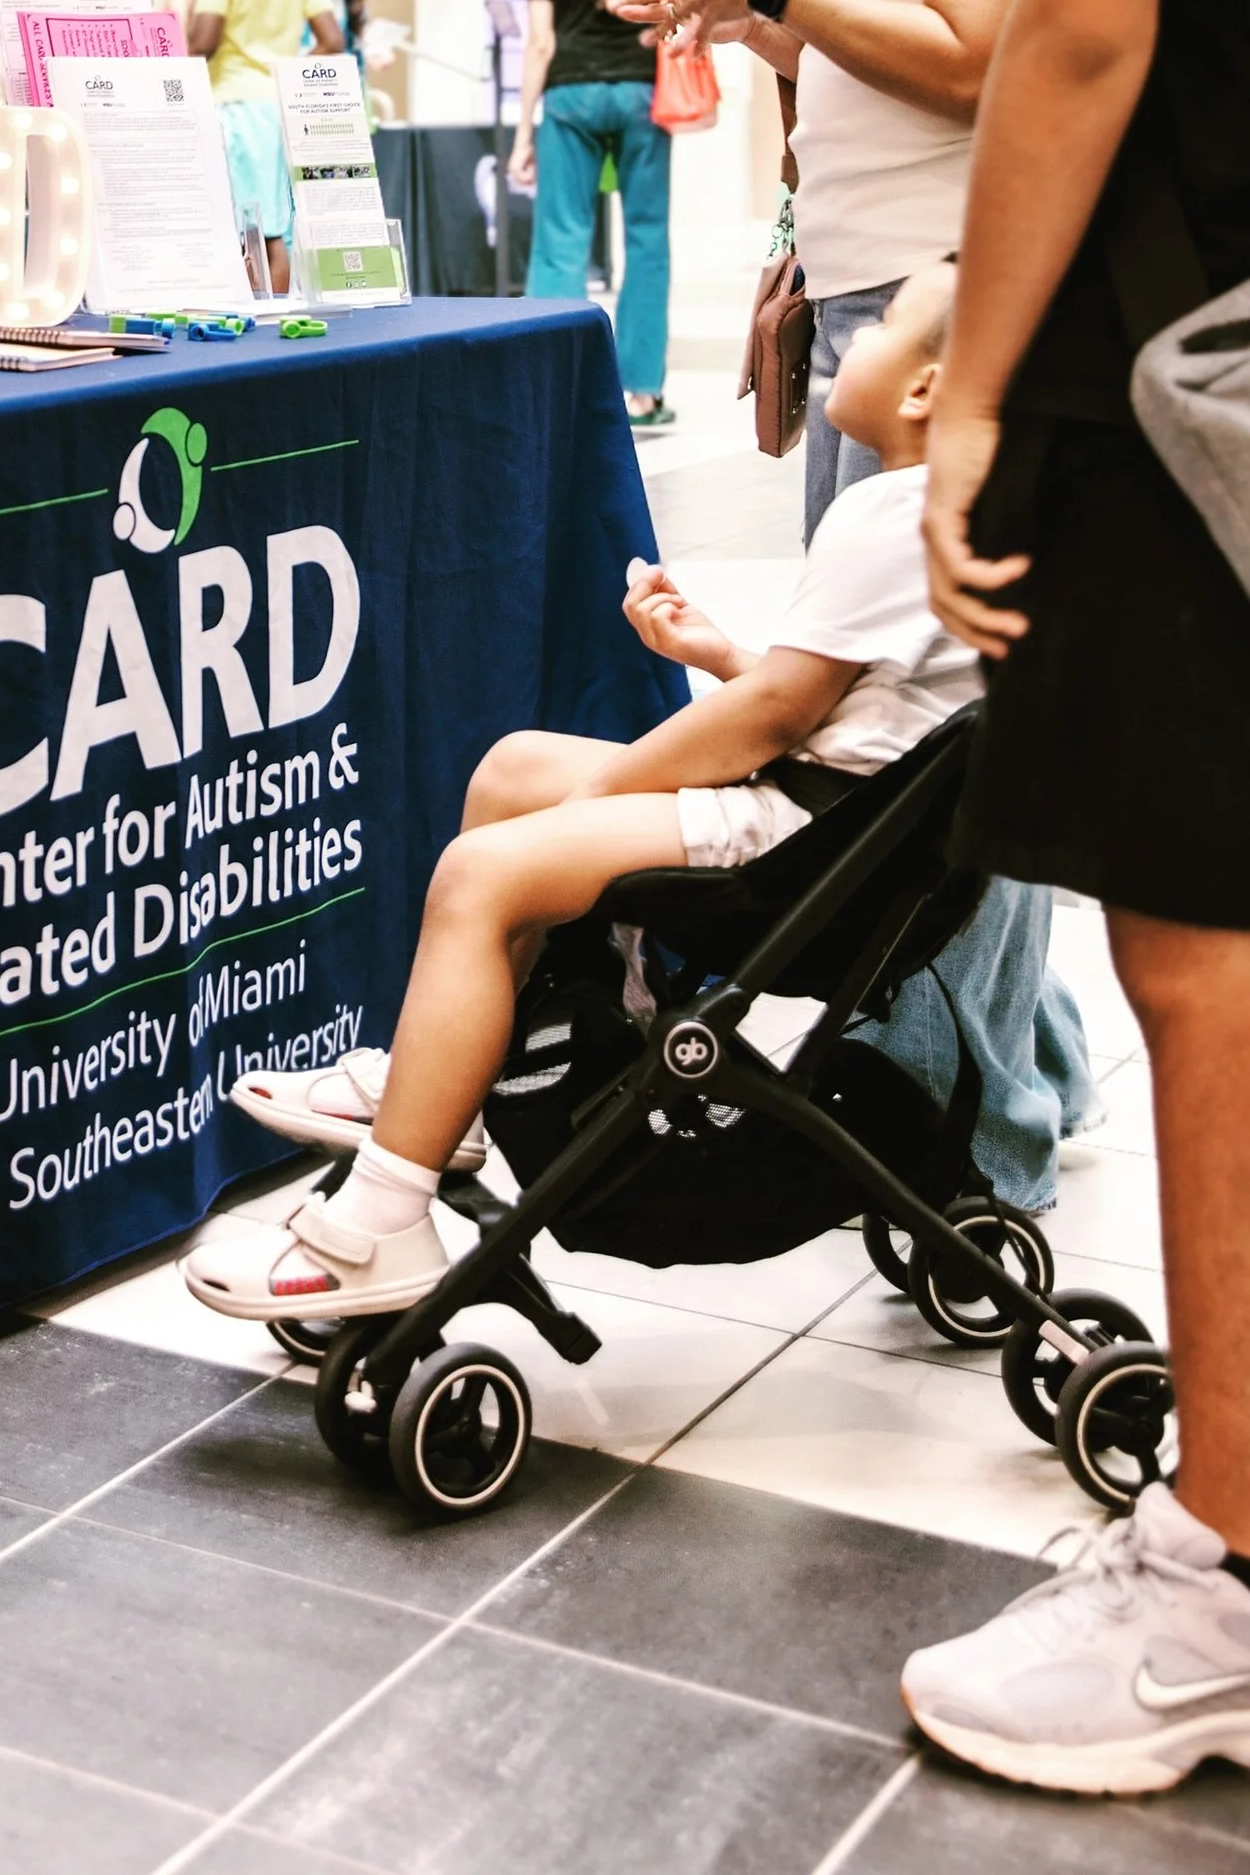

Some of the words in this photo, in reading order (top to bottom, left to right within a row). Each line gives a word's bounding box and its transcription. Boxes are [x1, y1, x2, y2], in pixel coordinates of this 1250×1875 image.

[85, 80, 114, 91] CARD
[302, 68, 337, 79] CARD
[102, 793, 177, 875] for
[184, 748, 321, 850] Autism
[328, 721, 360, 790] &
[134, 816, 363, 958] Disabilities
[204, 938, 307, 1030] Miami
[674, 1036, 708, 1066] gb
